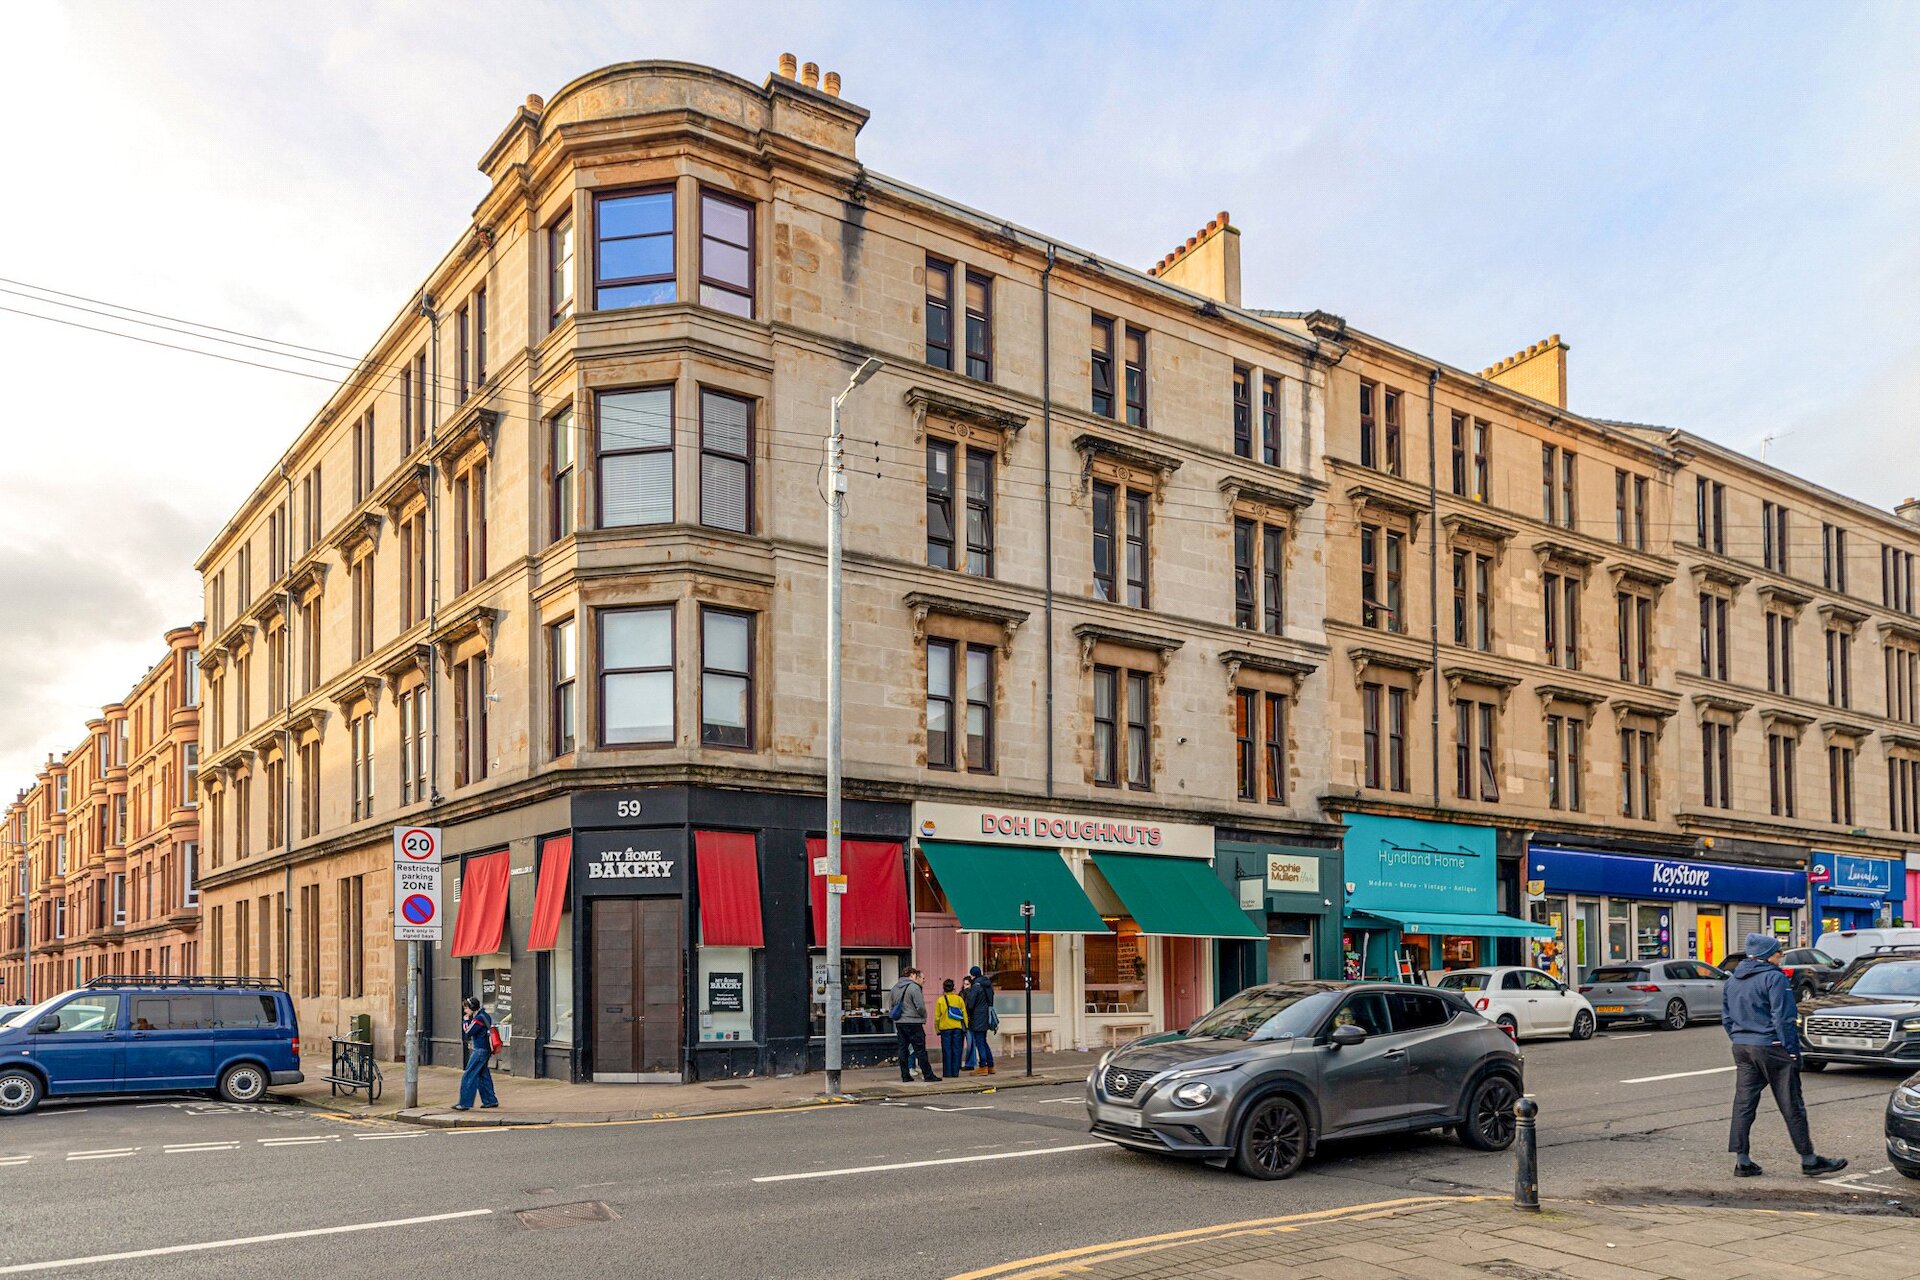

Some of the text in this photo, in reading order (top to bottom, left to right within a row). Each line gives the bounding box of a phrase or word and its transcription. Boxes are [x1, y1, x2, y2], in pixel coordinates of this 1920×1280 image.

[617, 800, 641, 817] 59
[982, 813, 1162, 845] DOH DOUGHNUTS
[407, 838, 430, 851] 20
[601, 847, 662, 861] MY HOME
[1378, 850, 1465, 868] Hyndland Home
[397, 864, 440, 873] Restricted
[588, 861, 674, 878] BAKERY
[1271, 862, 1301, 873] Sophie
[401, 873, 434, 881] parking
[1271, 872, 1299, 882] Mullen
[1652, 862, 1710, 887] KeyStore
[402, 882, 434, 890] ZONE
[1424, 882, 1447, 891] Vintage
[1454, 885, 1477, 893] Antique
[499, 985, 505, 993] TO
